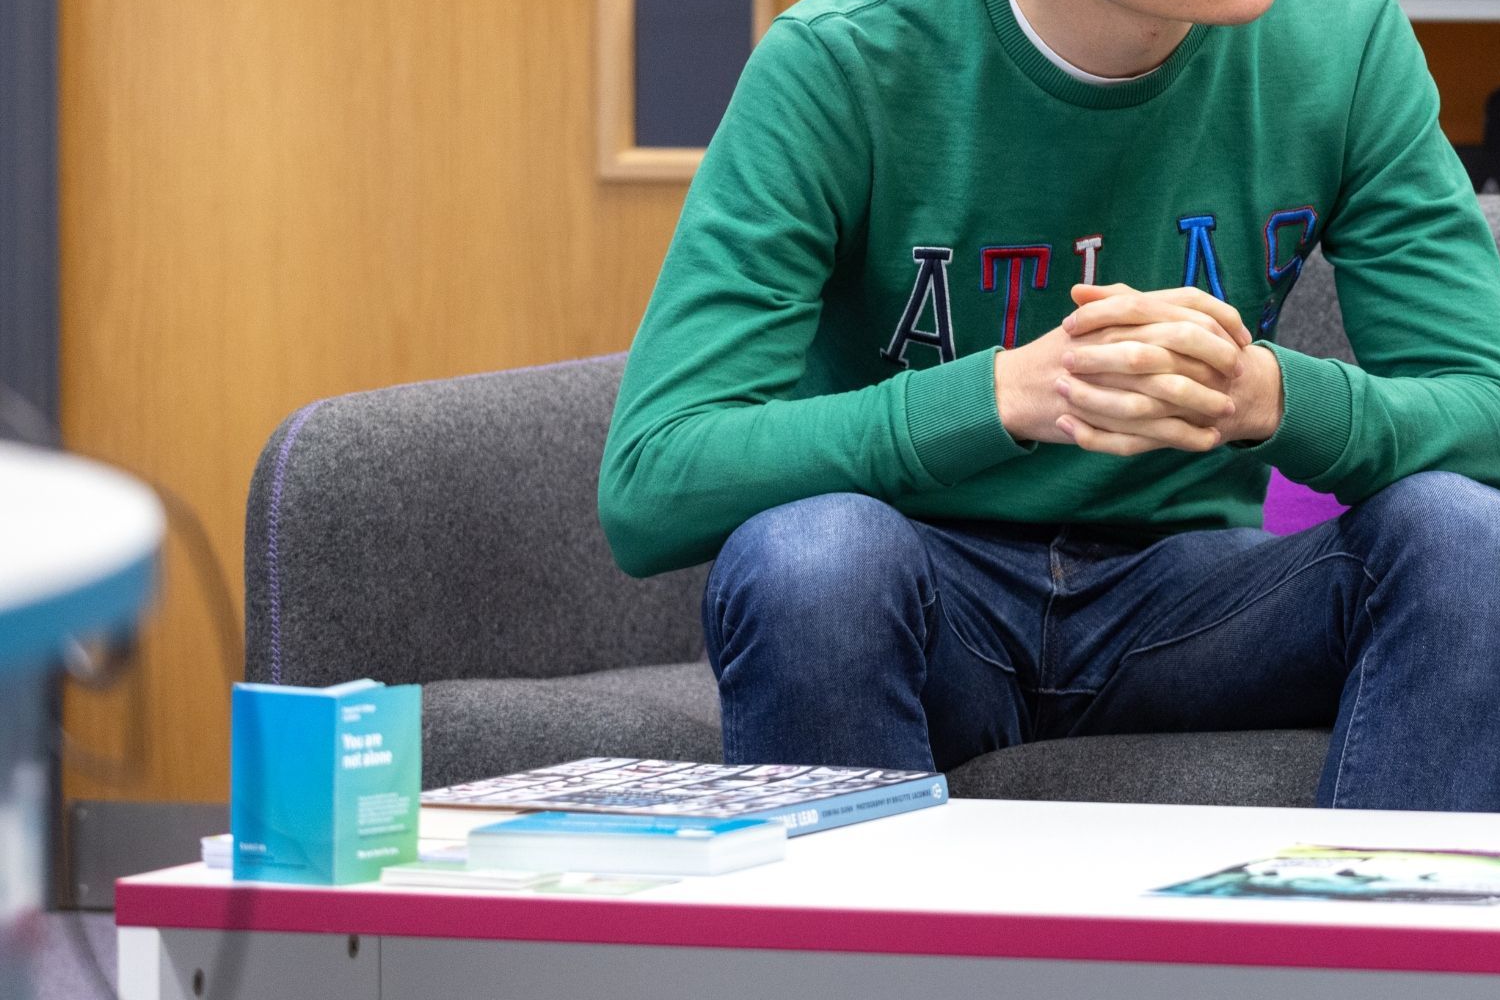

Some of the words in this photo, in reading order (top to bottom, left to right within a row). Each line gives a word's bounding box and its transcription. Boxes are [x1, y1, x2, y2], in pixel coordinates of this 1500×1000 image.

[342, 733, 364, 749] You
[365, 733, 384, 748] are
[342, 754, 362, 769] not
[363, 750, 393, 767] alone
